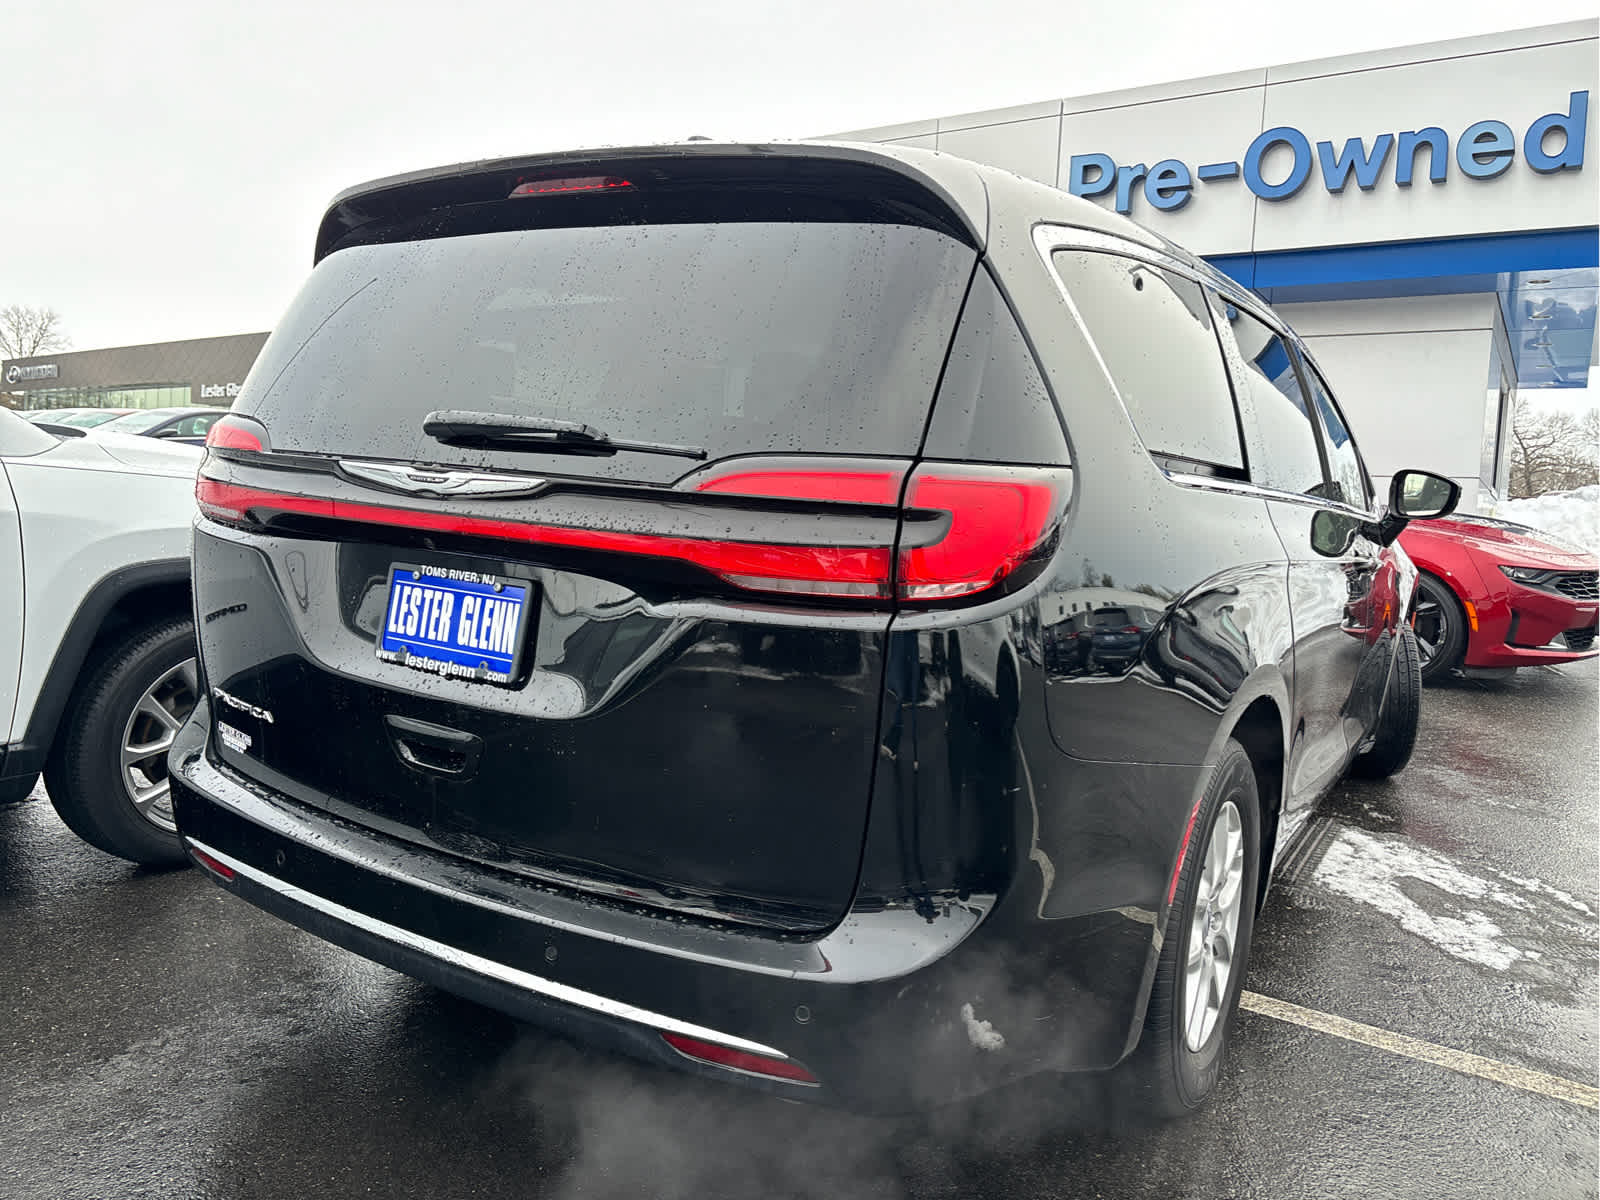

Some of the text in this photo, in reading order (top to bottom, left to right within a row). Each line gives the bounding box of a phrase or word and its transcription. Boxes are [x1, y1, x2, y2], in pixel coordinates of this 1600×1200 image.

[1068, 90, 1589, 214] Pre-Owned
[201, 384, 224, 398] Lester
[420, 565, 496, 585] TOMS RIVER, NJ
[388, 584, 520, 655] LESTER GLENN
